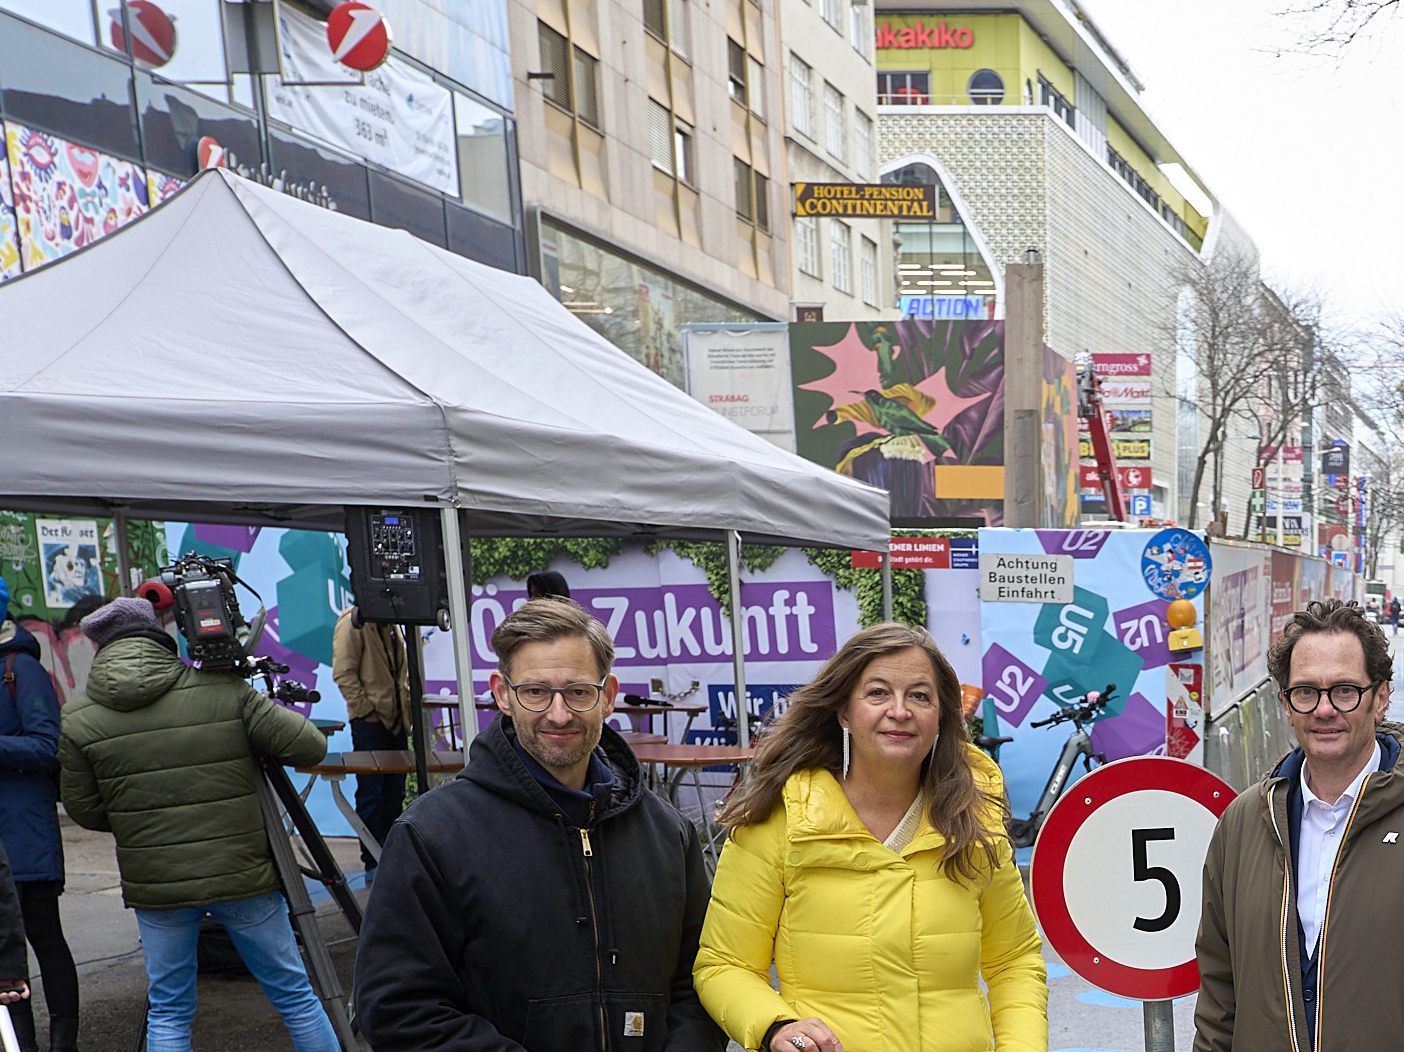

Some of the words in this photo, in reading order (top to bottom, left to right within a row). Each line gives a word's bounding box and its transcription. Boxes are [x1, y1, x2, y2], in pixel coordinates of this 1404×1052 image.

[813, 185, 924, 200] HOTEL-PENSION
[805, 199, 933, 217] CONTINENTAL
[908, 298, 981, 319] ACTION
[708, 395, 749, 403] STRABAG
[889, 543, 912, 552] ENER
[913, 543, 945, 552] LINIEN
[1062, 530, 1100, 551] U2
[997, 557, 1058, 572] Achtung
[989, 572, 1066, 585] Baustellen
[998, 587, 1056, 599] Einfahrt
[592, 589, 818, 660] Zukunft
[1051, 604, 1095, 655] U5
[1120, 614, 1163, 652] U2
[987, 665, 1034, 713] U2
[1050, 764, 1067, 795] CUBE
[1131, 827, 1182, 933] 5
